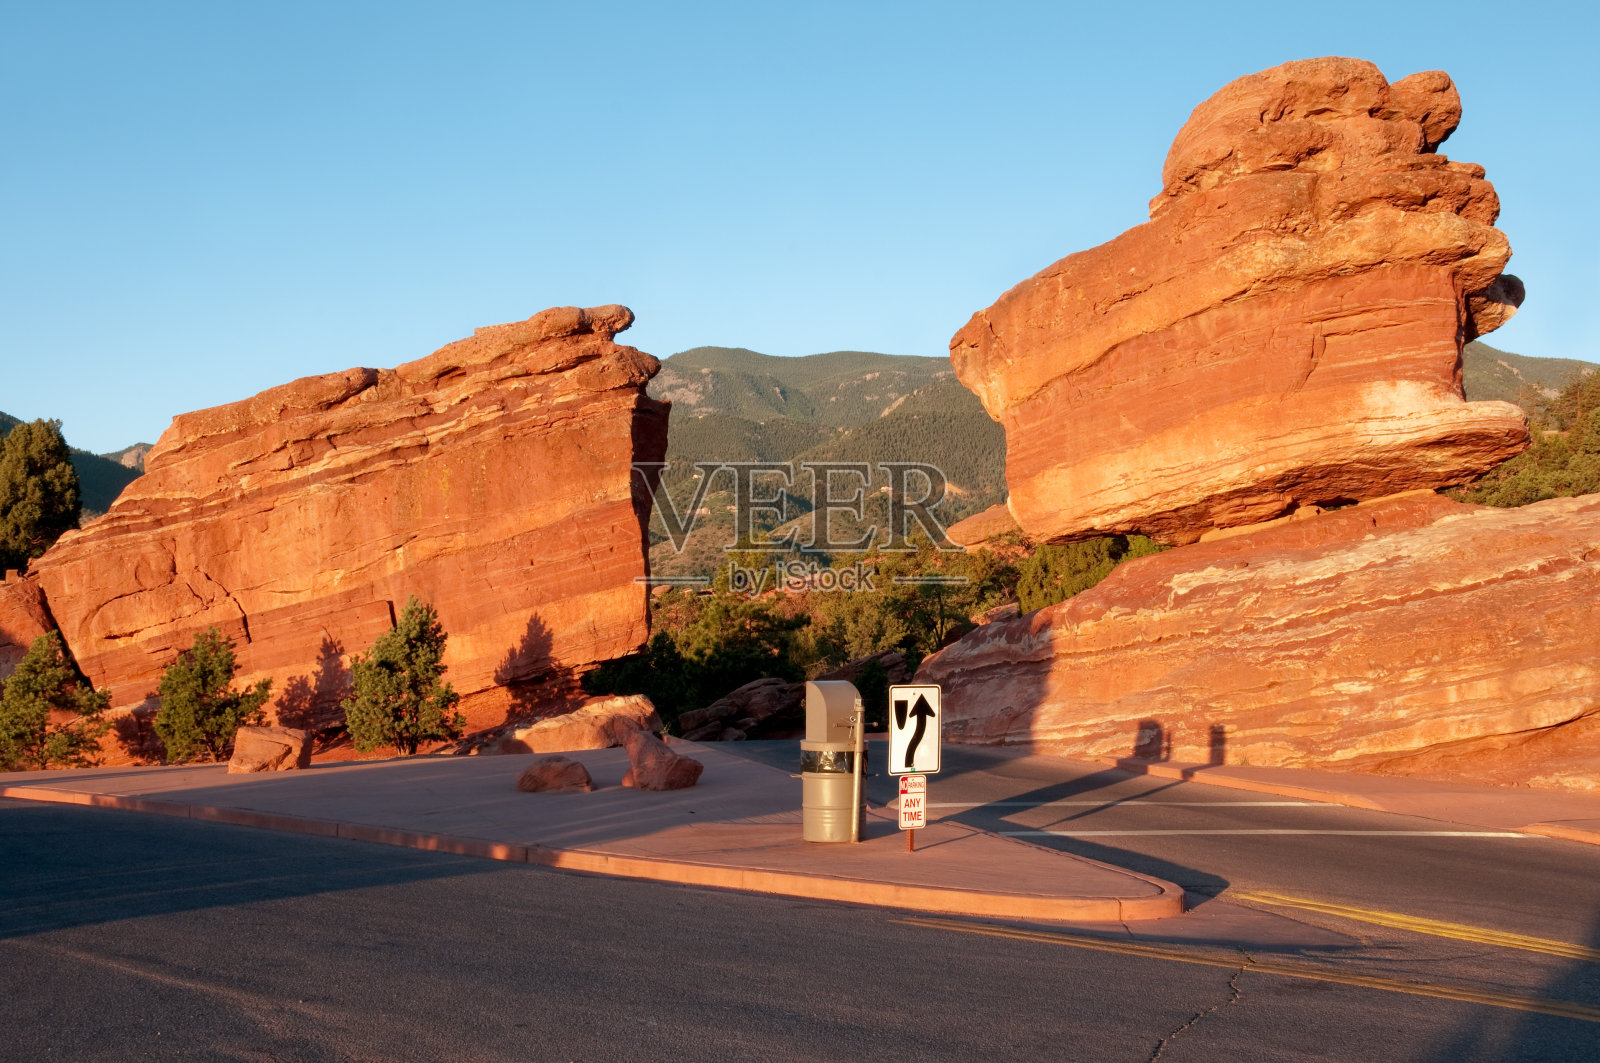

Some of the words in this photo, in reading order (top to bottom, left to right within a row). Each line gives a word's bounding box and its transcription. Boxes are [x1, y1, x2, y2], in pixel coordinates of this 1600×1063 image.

[901, 780, 908, 790] NO
[908, 781, 924, 789] PARKING
[904, 798, 921, 808] ANY
[903, 811, 922, 821] TIME
